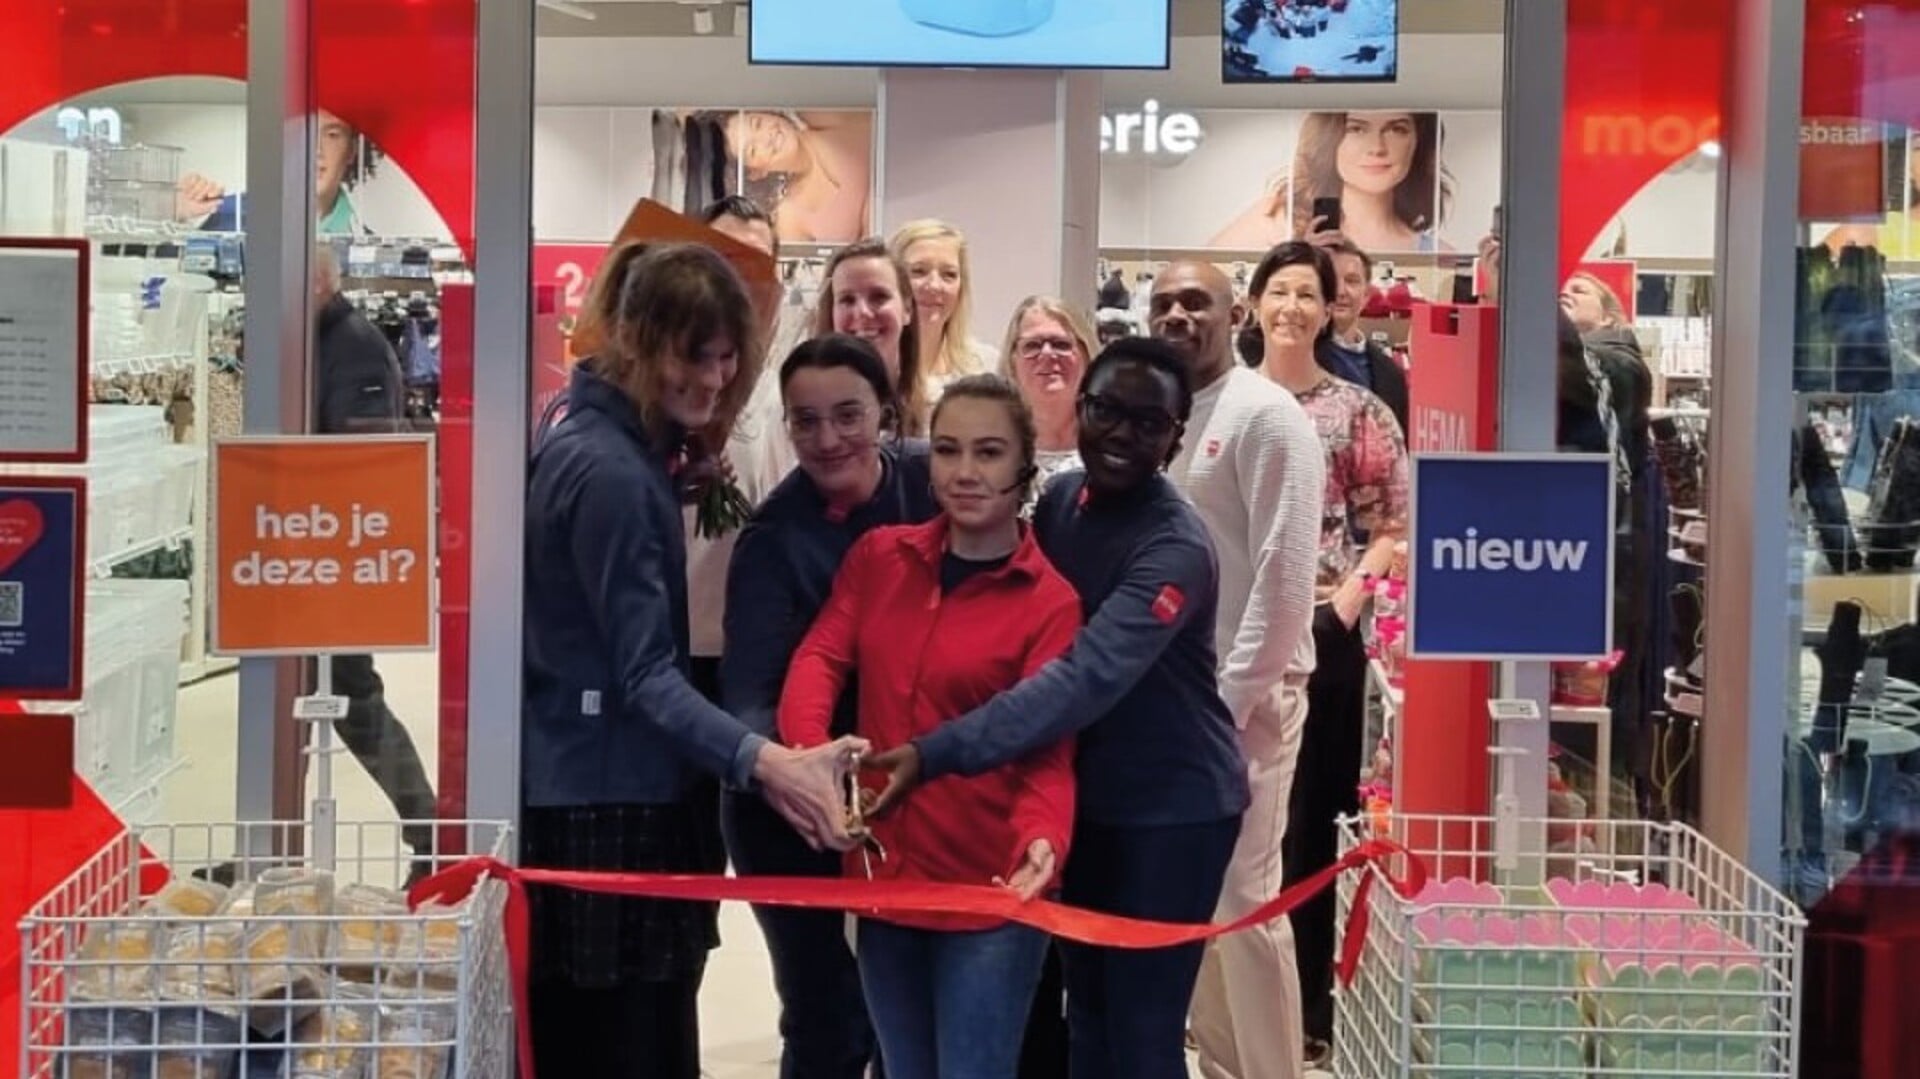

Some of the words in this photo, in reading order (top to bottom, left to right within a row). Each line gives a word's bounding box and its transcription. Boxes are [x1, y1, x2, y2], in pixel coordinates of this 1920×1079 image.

[256, 503, 340, 540] heb
[347, 502, 390, 548] je
[231, 550, 341, 586] deze
[352, 548, 416, 584] al?
[1432, 526, 1589, 571] nieuw
